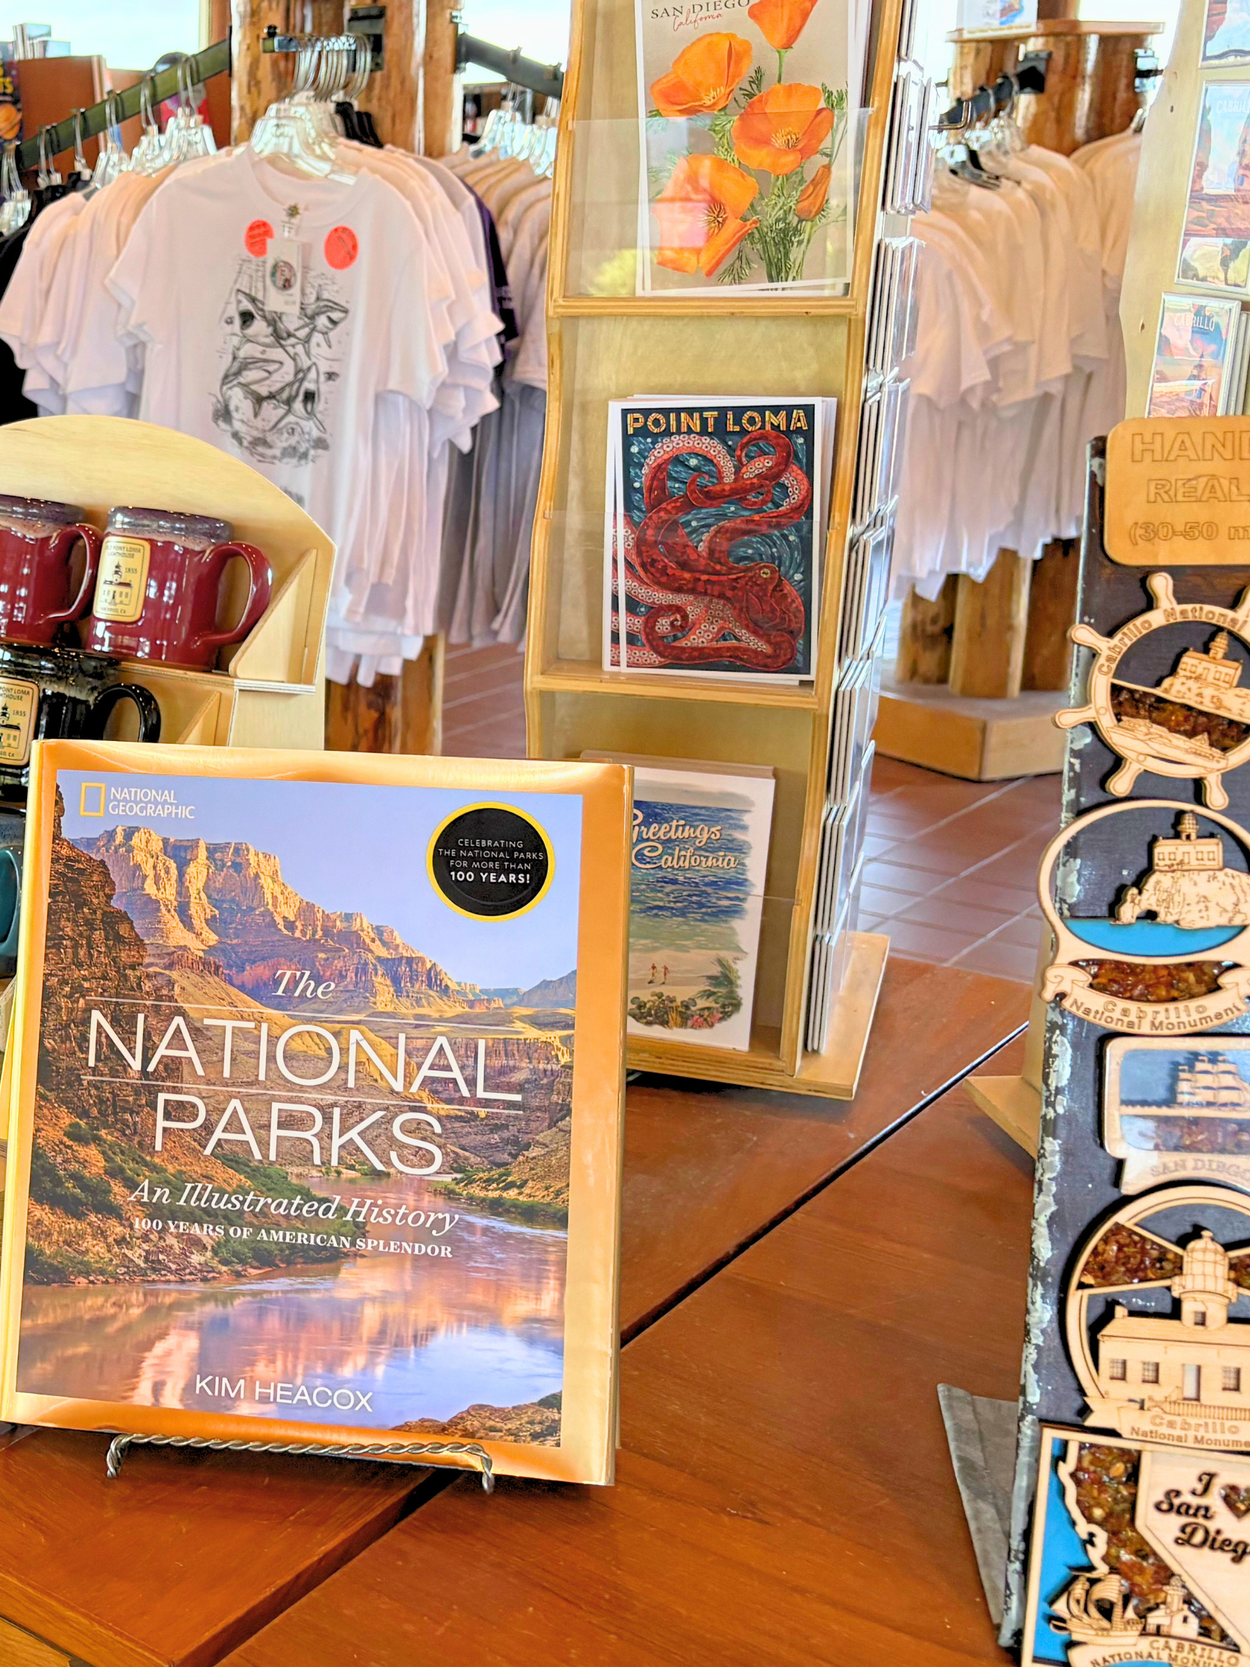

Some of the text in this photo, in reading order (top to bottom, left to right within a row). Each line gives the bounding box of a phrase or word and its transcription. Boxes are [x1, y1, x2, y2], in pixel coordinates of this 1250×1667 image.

[651, 0, 751, 19] SAN DIEGO
[673, 8, 724, 32] California
[1174, 313, 1215, 332] CABRILLO
[626, 409, 809, 435] POINT LOMA
[1129, 521, 1219, 546] (30-50
[1097, 606, 1249, 676] Cabrillo National
[110, 788, 178, 804] NATIONAL
[108, 801, 196, 820] GEOGRAPHIC
[437, 848, 545, 860] THE NATIONAL PARKS
[457, 838, 524, 849] CELEBRATING
[449, 860, 532, 870] FOR MORE THAN
[631, 842, 739, 870] California
[450, 871, 531, 884] 100 YEARS!
[271, 969, 336, 1001] The
[1069, 999, 1242, 1032] National Monument
[1103, 999, 1208, 1021] Cabrillo
[87, 1008, 524, 1102] NATIONAL
[154, 1092, 445, 1177] PARKS
[1150, 1160, 1187, 1178] SAN
[128, 1178, 461, 1238] An Illustrated History
[133, 1216, 454, 1258] 100 YEARS OF AMERICAN SPLENDOR
[194, 1374, 374, 1413] KIM HEACOX
[1129, 1426, 1190, 1444] National
[1149, 1413, 1241, 1436] Cabrillo
[1154, 1489, 1216, 1521] San
[1149, 1638, 1240, 1667] CABRILLO
